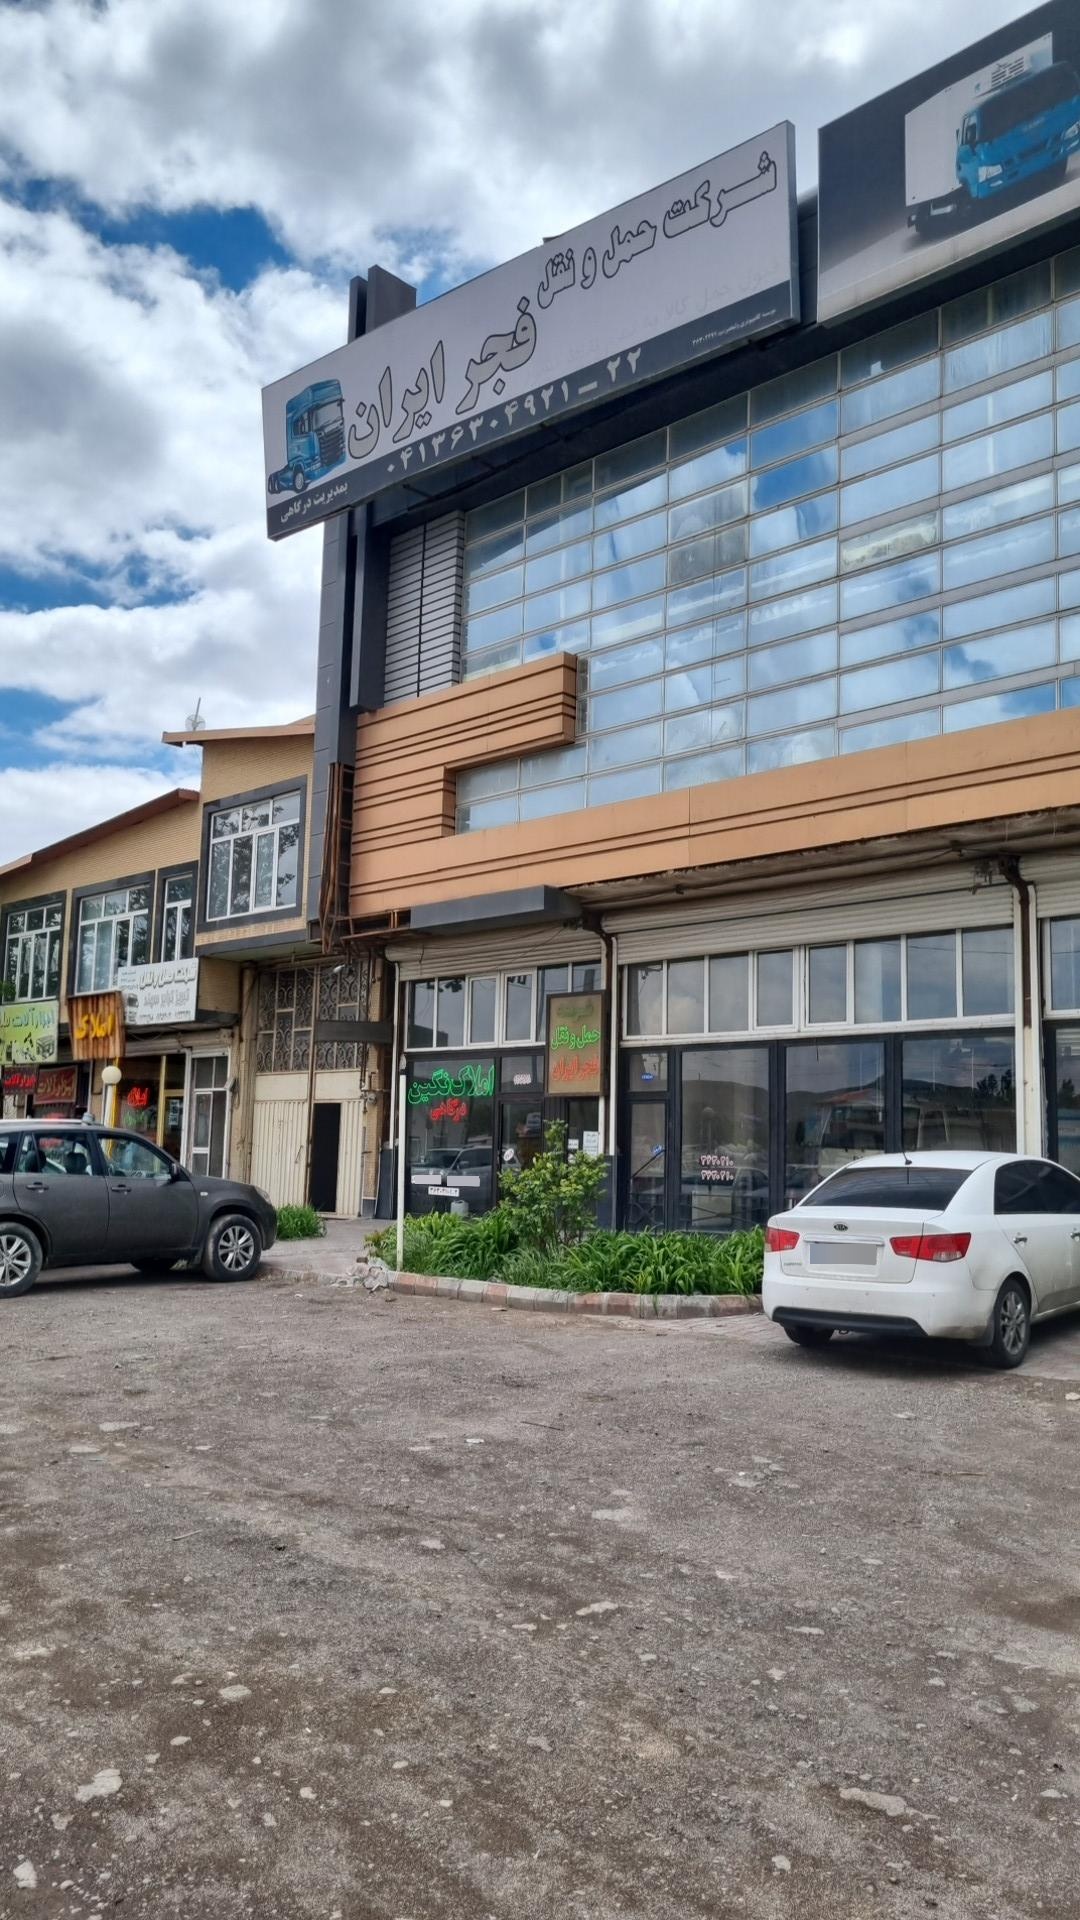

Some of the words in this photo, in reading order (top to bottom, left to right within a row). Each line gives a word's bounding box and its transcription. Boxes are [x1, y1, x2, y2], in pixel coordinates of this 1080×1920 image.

[662, 150, 777, 239] شرکت
[602, 219, 657, 279] حمل
[537, 247, 576, 310] نقل
[580, 246, 597, 290] و
[455, 296, 537, 416] فجر
[347, 339, 447, 460] ایران
[313, 482, 348, 505] بمدیریت
[280, 499, 312, 523] درگاهی
[75, 1013, 116, 1040] املاک
[551, 1025, 569, 1050] نقل
[576, 1025, 601, 1049] حمل
[408, 1068, 452, 1104] نگین
[451, 1065, 495, 1097] املاک
[430, 1098, 467, 1122] درگاهی
